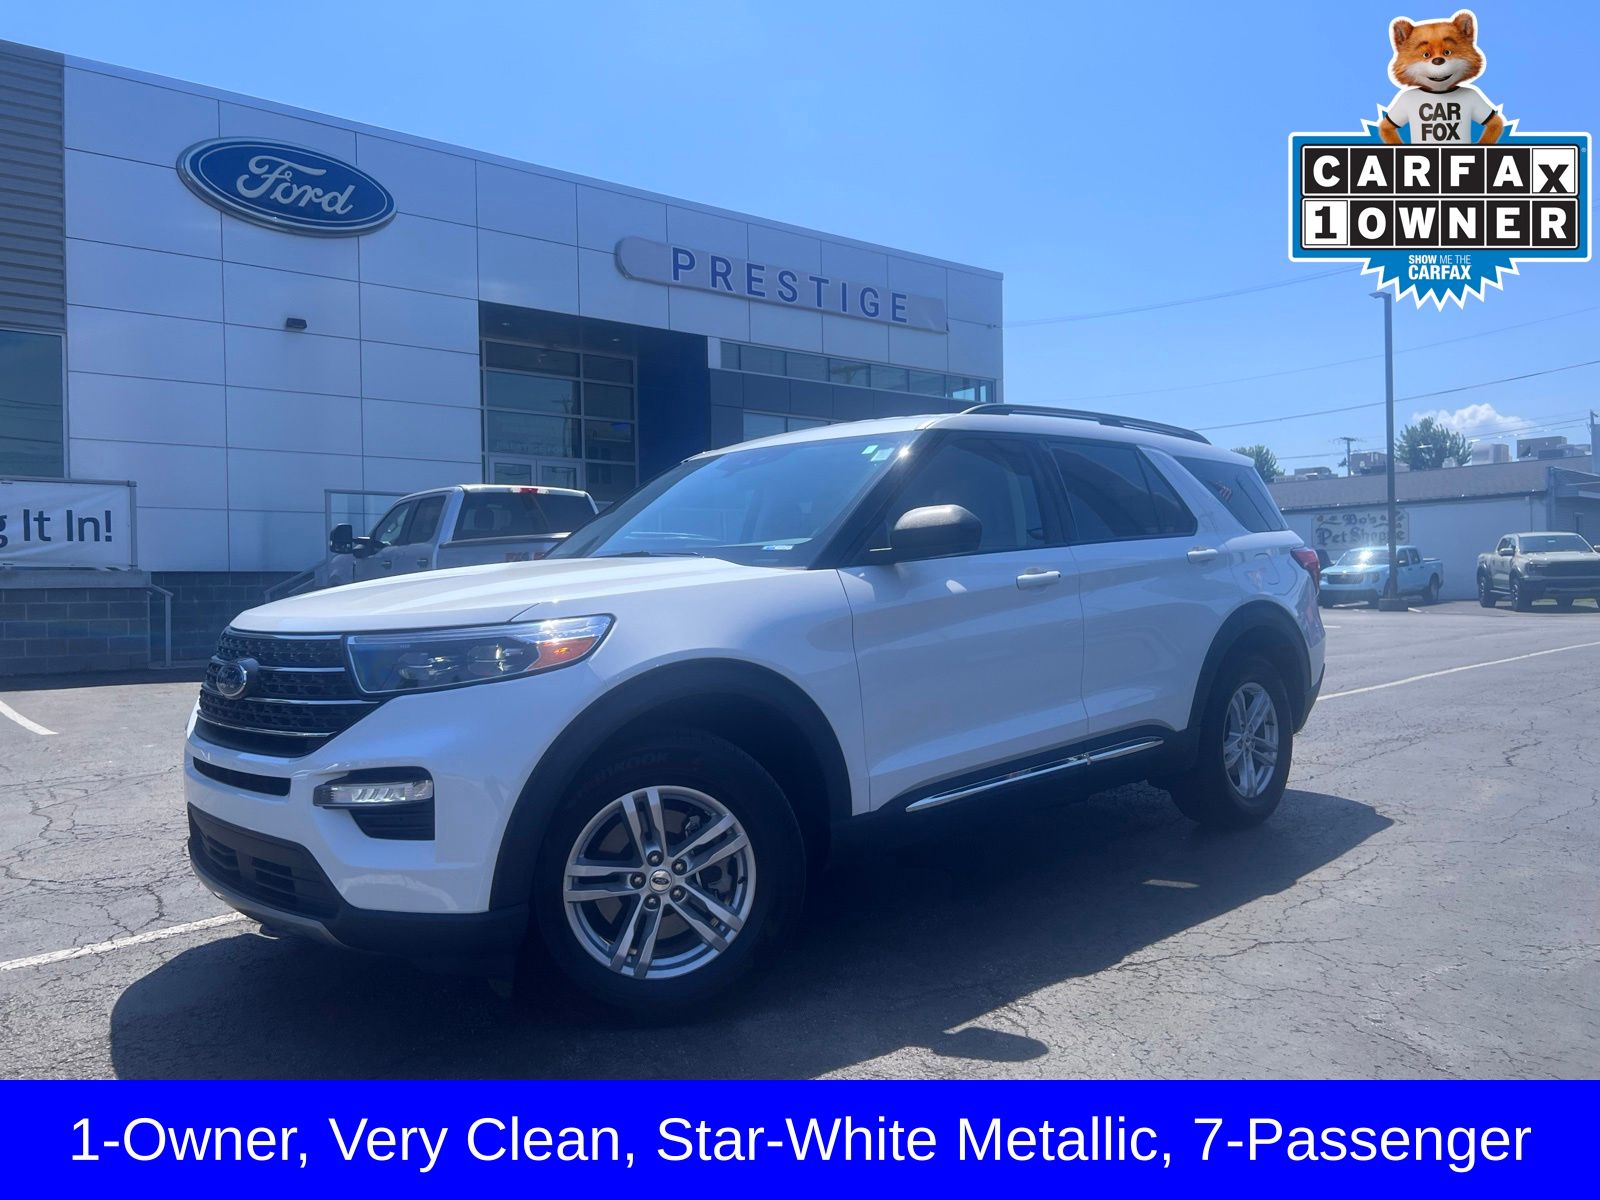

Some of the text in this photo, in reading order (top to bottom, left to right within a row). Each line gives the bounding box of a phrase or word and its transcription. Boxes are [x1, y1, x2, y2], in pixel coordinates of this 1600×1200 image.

[236, 155, 355, 215] Ford
[671, 246, 908, 323] PRESTIGE
[23, 509, 52, 542] It
[66, 509, 113, 542] In!
[1315, 526, 1405, 546] Pet Shope
